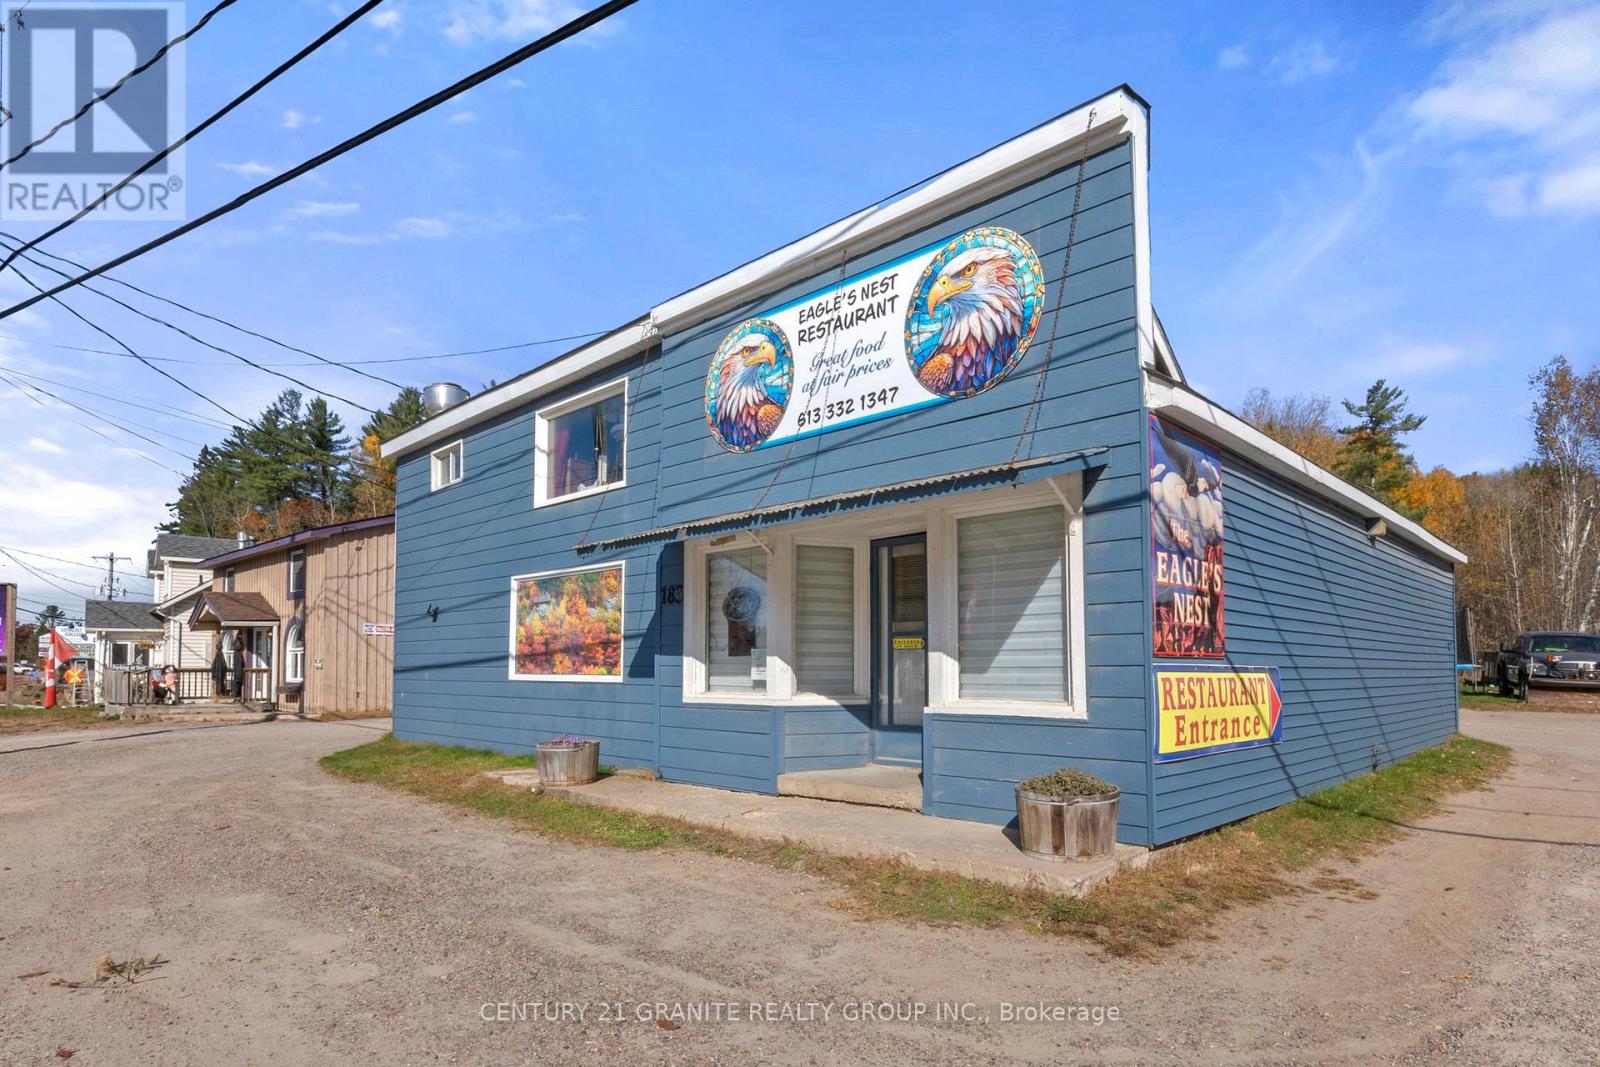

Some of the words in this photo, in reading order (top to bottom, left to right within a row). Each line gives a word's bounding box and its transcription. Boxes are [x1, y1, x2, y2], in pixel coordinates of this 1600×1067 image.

[799, 290, 856, 325] EAGLE'S
[861, 273, 898, 301] NEST
[798, 294, 899, 346] RESTAURANT
[810, 349, 847, 372] Great
[841, 330, 887, 368] food
[802, 378, 817, 394] at
[811, 369, 845, 396] fair
[844, 357, 892, 388] prices
[797, 407, 821, 428] 613
[826, 398, 855, 420] 332
[860, 386, 899, 410] 1347
[1170, 521, 1190, 543] The
[1156, 551, 1221, 593] EAGLE'S
[1173, 592, 1210, 627] NEST
[1161, 677, 1266, 711] RESTAURANT
[1175, 714, 1260, 746] Entrance
